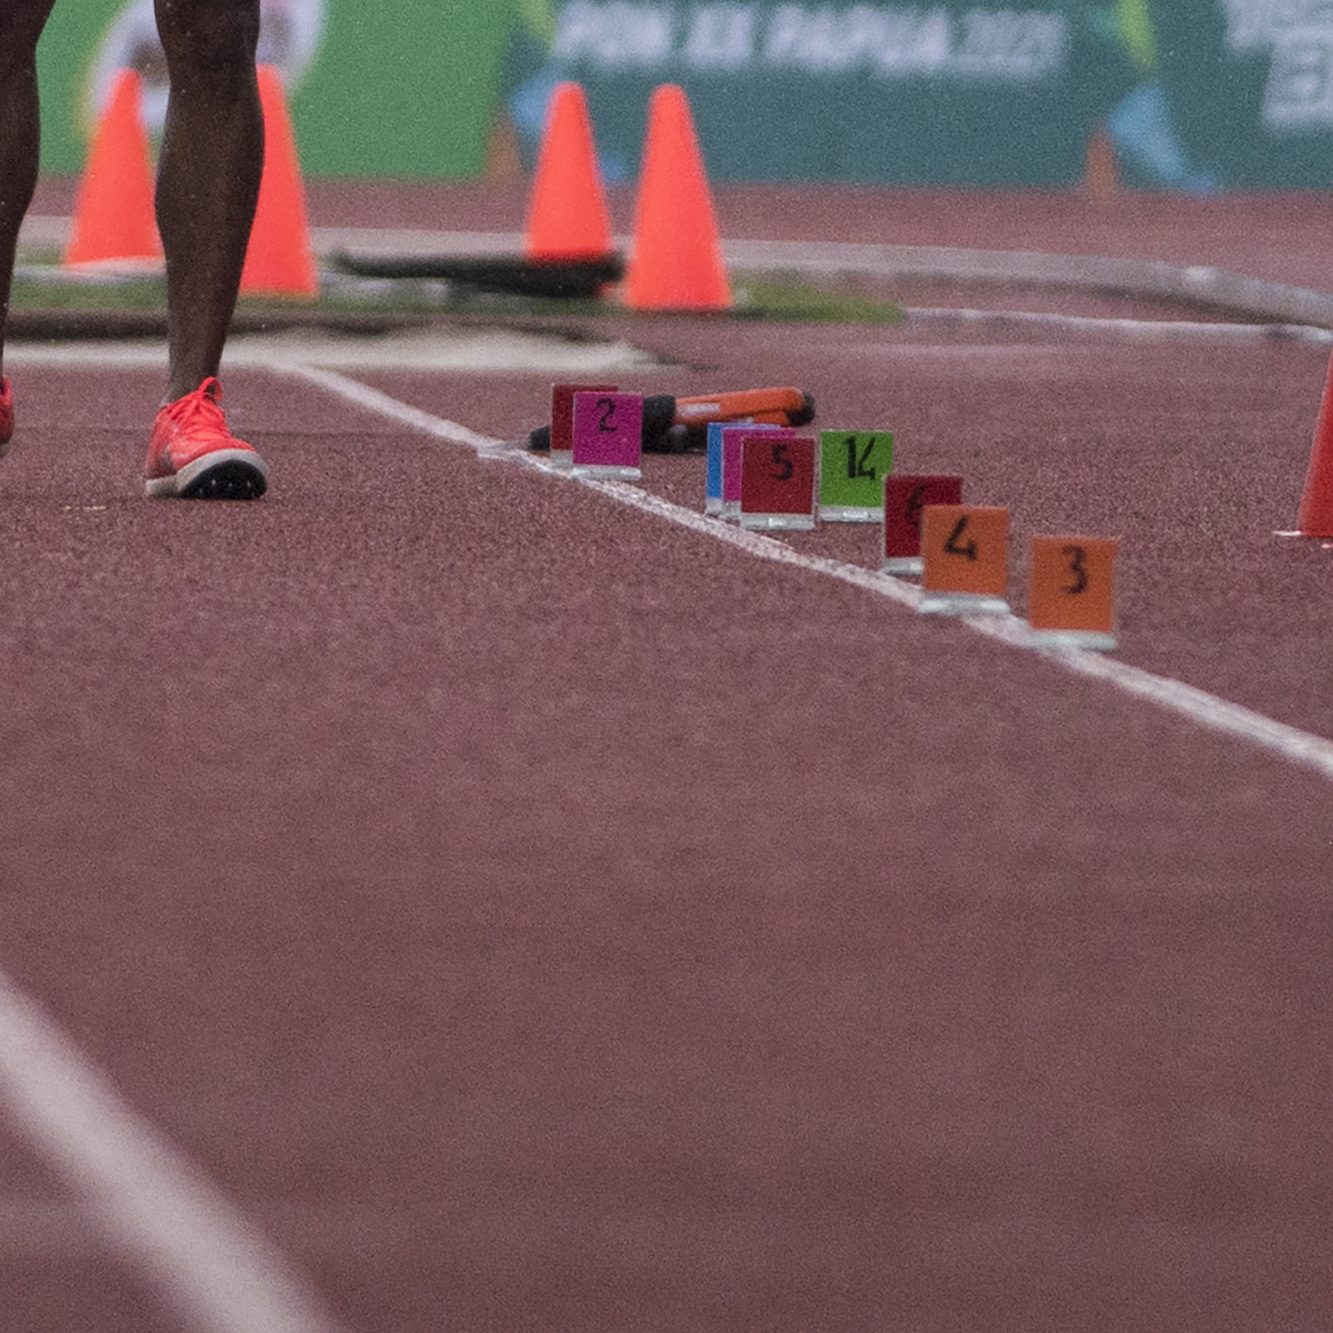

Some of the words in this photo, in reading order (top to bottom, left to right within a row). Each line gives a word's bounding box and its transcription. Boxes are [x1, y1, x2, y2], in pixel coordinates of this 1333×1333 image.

[767, 2, 949, 68] PAPUA
[595, 398, 618, 433] 2
[770, 444, 793, 481] 5
[843, 435, 877, 480] 14
[944, 515, 979, 561] 4
[1061, 545, 1088, 595] 3
